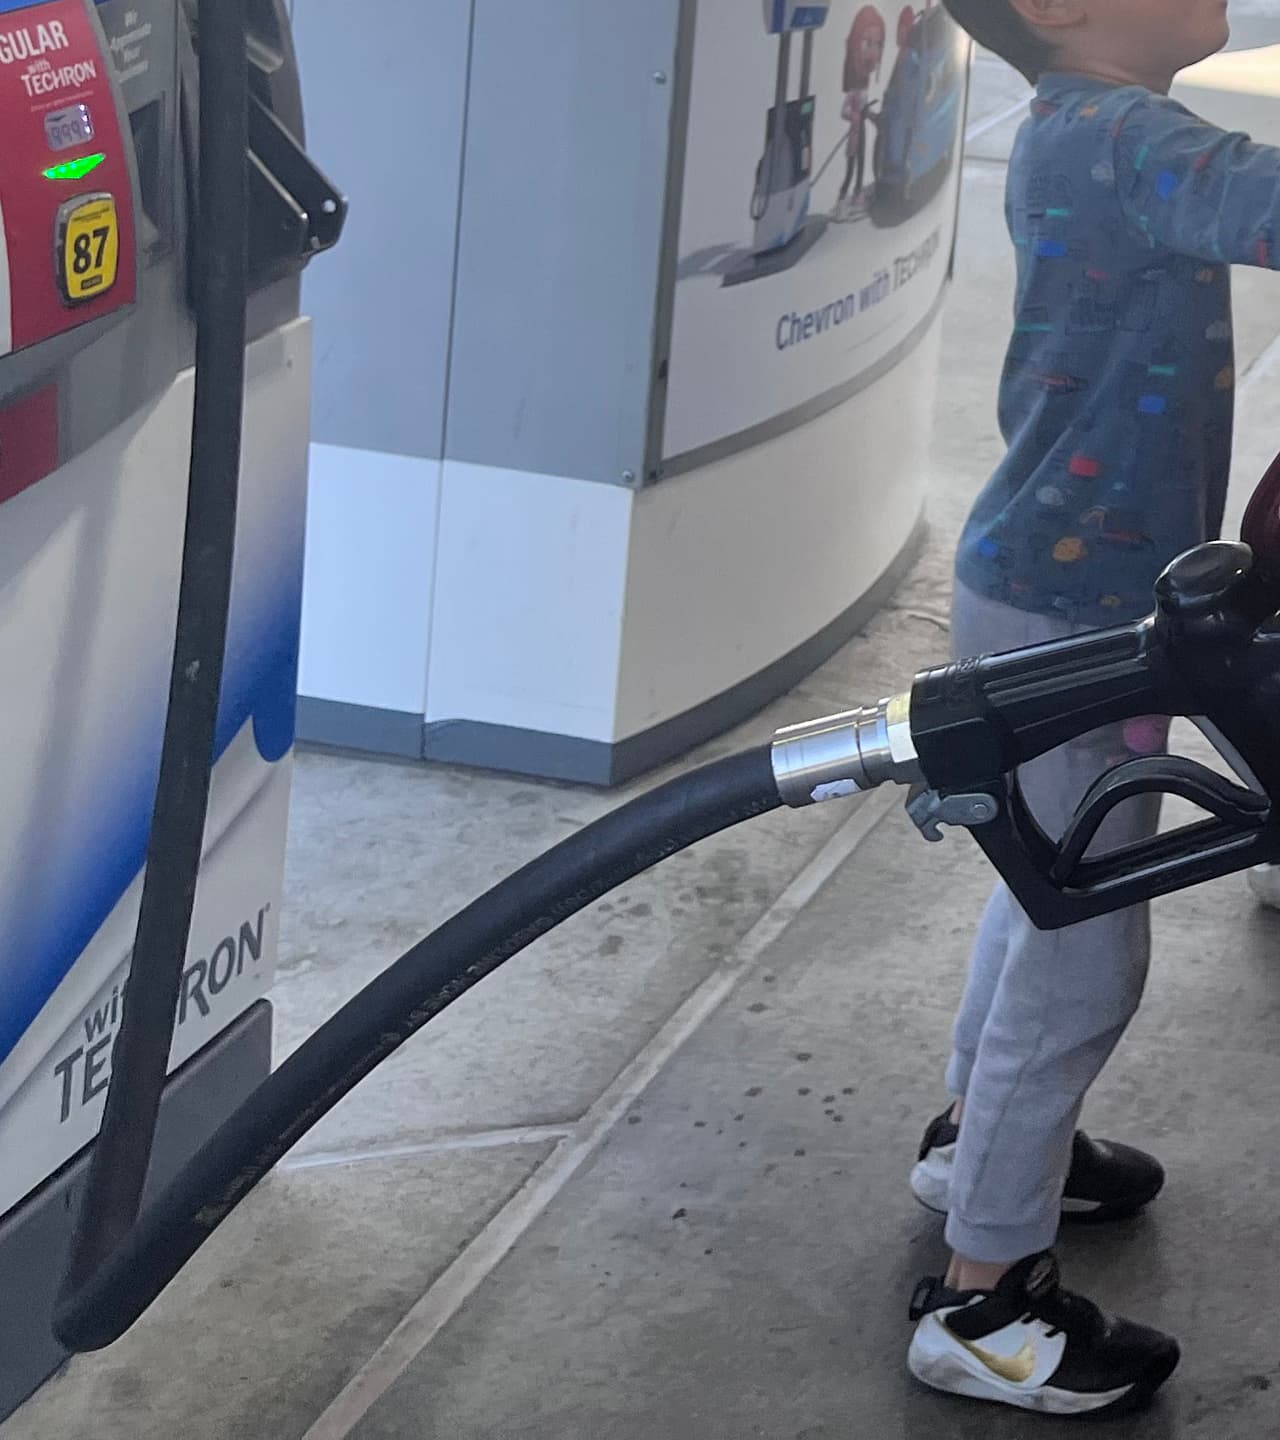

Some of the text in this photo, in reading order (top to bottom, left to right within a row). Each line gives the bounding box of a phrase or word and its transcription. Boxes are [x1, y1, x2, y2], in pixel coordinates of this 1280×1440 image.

[21, 60, 97, 97] TECHRON
[73, 226, 110, 275] 87
[775, 293, 855, 351] Chevron
[84, 984, 125, 1043] wi
